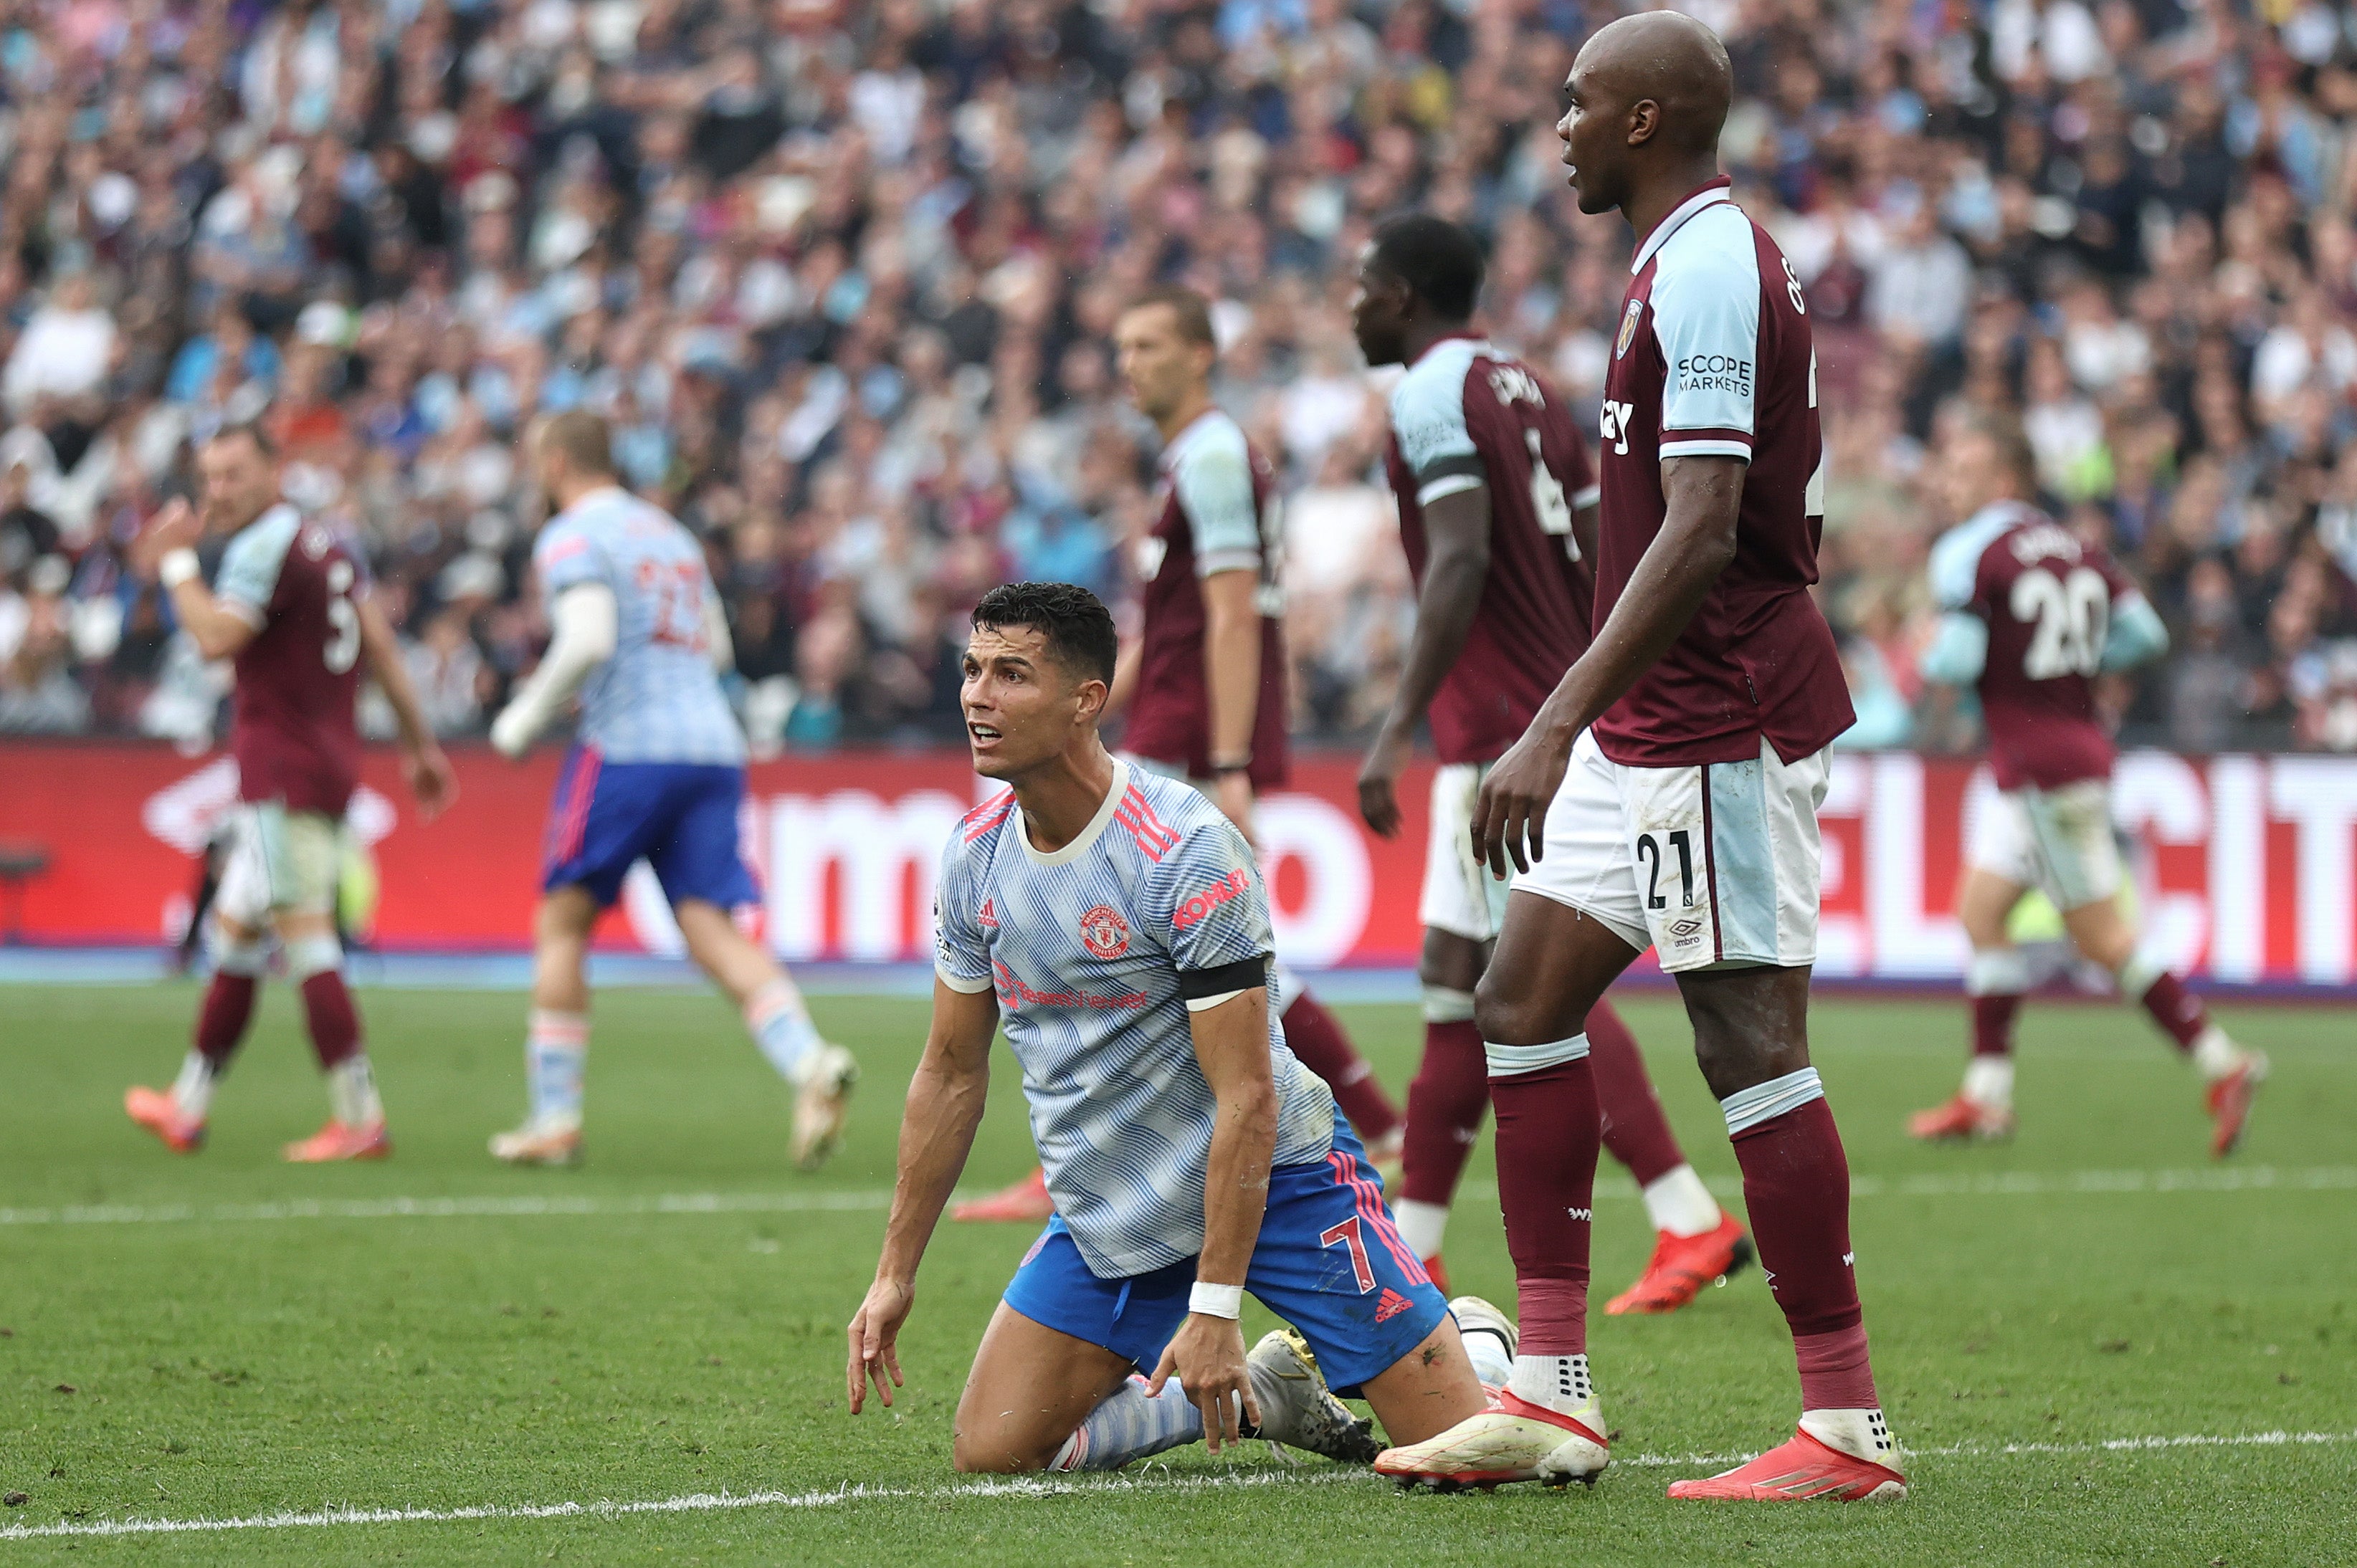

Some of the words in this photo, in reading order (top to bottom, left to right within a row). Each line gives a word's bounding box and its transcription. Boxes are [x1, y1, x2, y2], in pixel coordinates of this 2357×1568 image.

[1678, 355, 1751, 381] SCOPE
[1678, 376, 1750, 397] MARKETS
[2009, 566, 2110, 681] 20
[1637, 830, 1694, 909] 21
[1173, 868, 1250, 931] KOHLER
[1084, 908, 1125, 929] MANCHESTER
[1092, 945, 1122, 957] UNITED
[1674, 936, 1700, 947] umbro
[1014, 980, 1148, 1010] TeamViewer
[1319, 1215, 1376, 1295] 7
